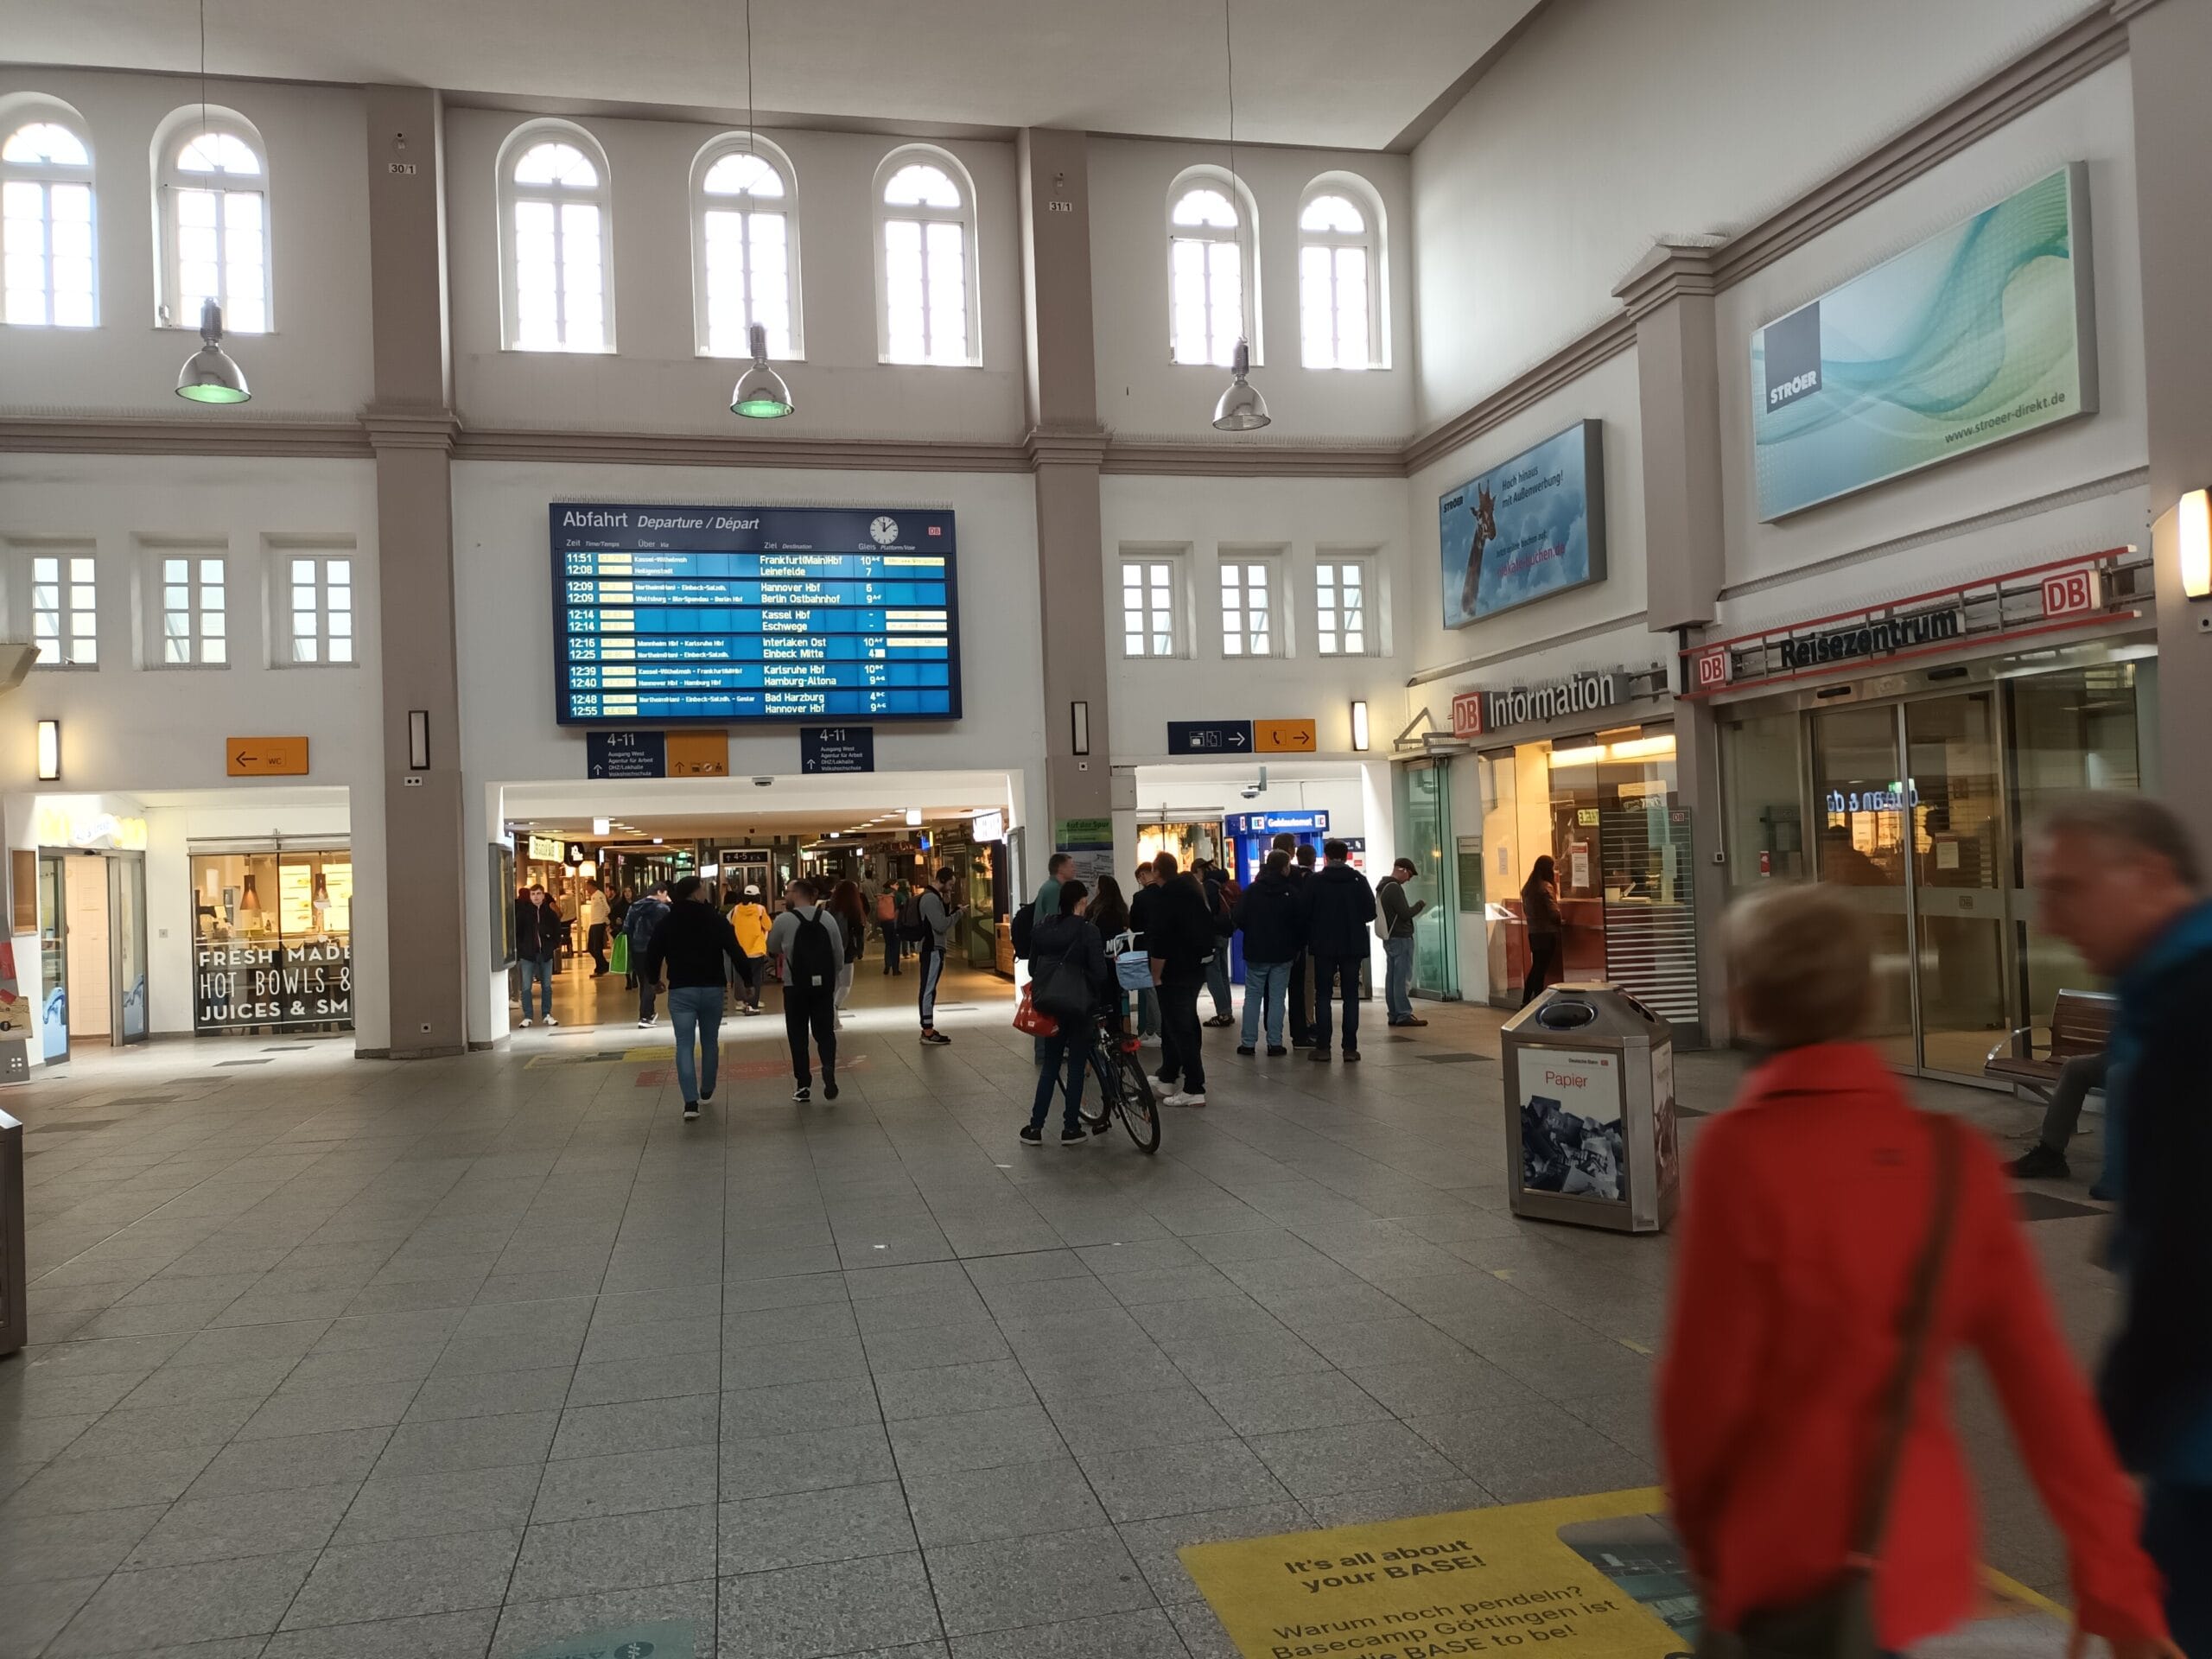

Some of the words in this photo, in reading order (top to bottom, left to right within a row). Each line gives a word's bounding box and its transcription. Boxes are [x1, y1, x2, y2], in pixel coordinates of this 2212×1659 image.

[391, 164, 413, 173] 30/1
[1770, 369, 1817, 404] STRÖER
[1944, 391, 2066, 444] www.stroeer-direkt.de
[1502, 477, 1517, 490] Hoch
[1517, 467, 1538, 482] hinaus
[1502, 494, 1512, 508] mit
[1514, 470, 1564, 503] Außenwerbung!
[1443, 496, 1464, 513] STRÖER
[563, 511, 628, 527] Abfahrt
[638, 515, 702, 530] Departure
[715, 517, 760, 531] Départ
[639, 538, 655, 548] Über
[567, 554, 592, 563] 11:51
[760, 556, 842, 565] Frankfurt(Main)Hbf
[567, 565, 593, 575] 12:08
[568, 582, 593, 591] 12:09
[761, 583, 802, 592] Hannover
[805, 583, 820, 592] Hbf
[568, 594, 594, 602] 12:09
[762, 594, 787, 603] Berlin
[790, 594, 841, 603] Ostbahnhof
[2046, 576, 2087, 611] DB
[569, 611, 594, 620] 12:14
[796, 610, 810, 619] Hbf
[569, 622, 594, 631] 12:14
[762, 622, 807, 631] Eschwege
[569, 639, 595, 647] 12:16
[763, 638, 808, 646] Interlaken
[811, 638, 826, 646] Ost
[1780, 608, 1959, 669] Reisezentrum
[569, 650, 595, 659] 12:25
[764, 649, 797, 658] Einbeck
[800, 649, 823, 658] Mitte
[570, 667, 596, 676] 12:39
[764, 665, 807, 674] Karlsruhe
[810, 665, 825, 674] Hbf
[1700, 656, 1724, 683] DB
[571, 678, 596, 687] 12:40
[764, 677, 836, 687] Hamburg-Altona
[571, 695, 597, 704] 12:48
[766, 693, 781, 702] Bad
[785, 693, 824, 703] Harzburg
[1456, 700, 1480, 732] DB
[1490, 674, 1615, 728] Information
[572, 707, 598, 715] 12:55
[810, 703, 825, 713] Hbf
[607, 734, 635, 746] 4-11
[820, 729, 845, 741] 4-11
[200, 950, 273, 967] FRESH
[200, 972, 237, 999] HOT
[256, 967, 325, 995] BOWLS
[340, 967, 351, 992] &
[200, 1001, 281, 1021] JUICES
[290, 1001, 305, 1015] &
[1545, 1071, 1587, 1090] Papier
[1284, 1555, 1335, 1575] It's
[1338, 1551, 1377, 1571] all
[1380, 1537, 1474, 1564] about
[1301, 1569, 1376, 1594] your
[1385, 1554, 1488, 1583] BASE!
[1272, 1614, 1377, 1642] Warum
[1382, 1604, 1456, 1626] noch
[1459, 1585, 1586, 1618] pendeln?
[1271, 1625, 1428, 1659] Basecamp
[1433, 1604, 1577, 1637] Göttingen
[1580, 1599, 1622, 1618] ist
[1395, 1636, 1489, 1659] BASE
[1491, 1633, 1525, 1649] to
[1531, 1624, 1577, 1643] be!
